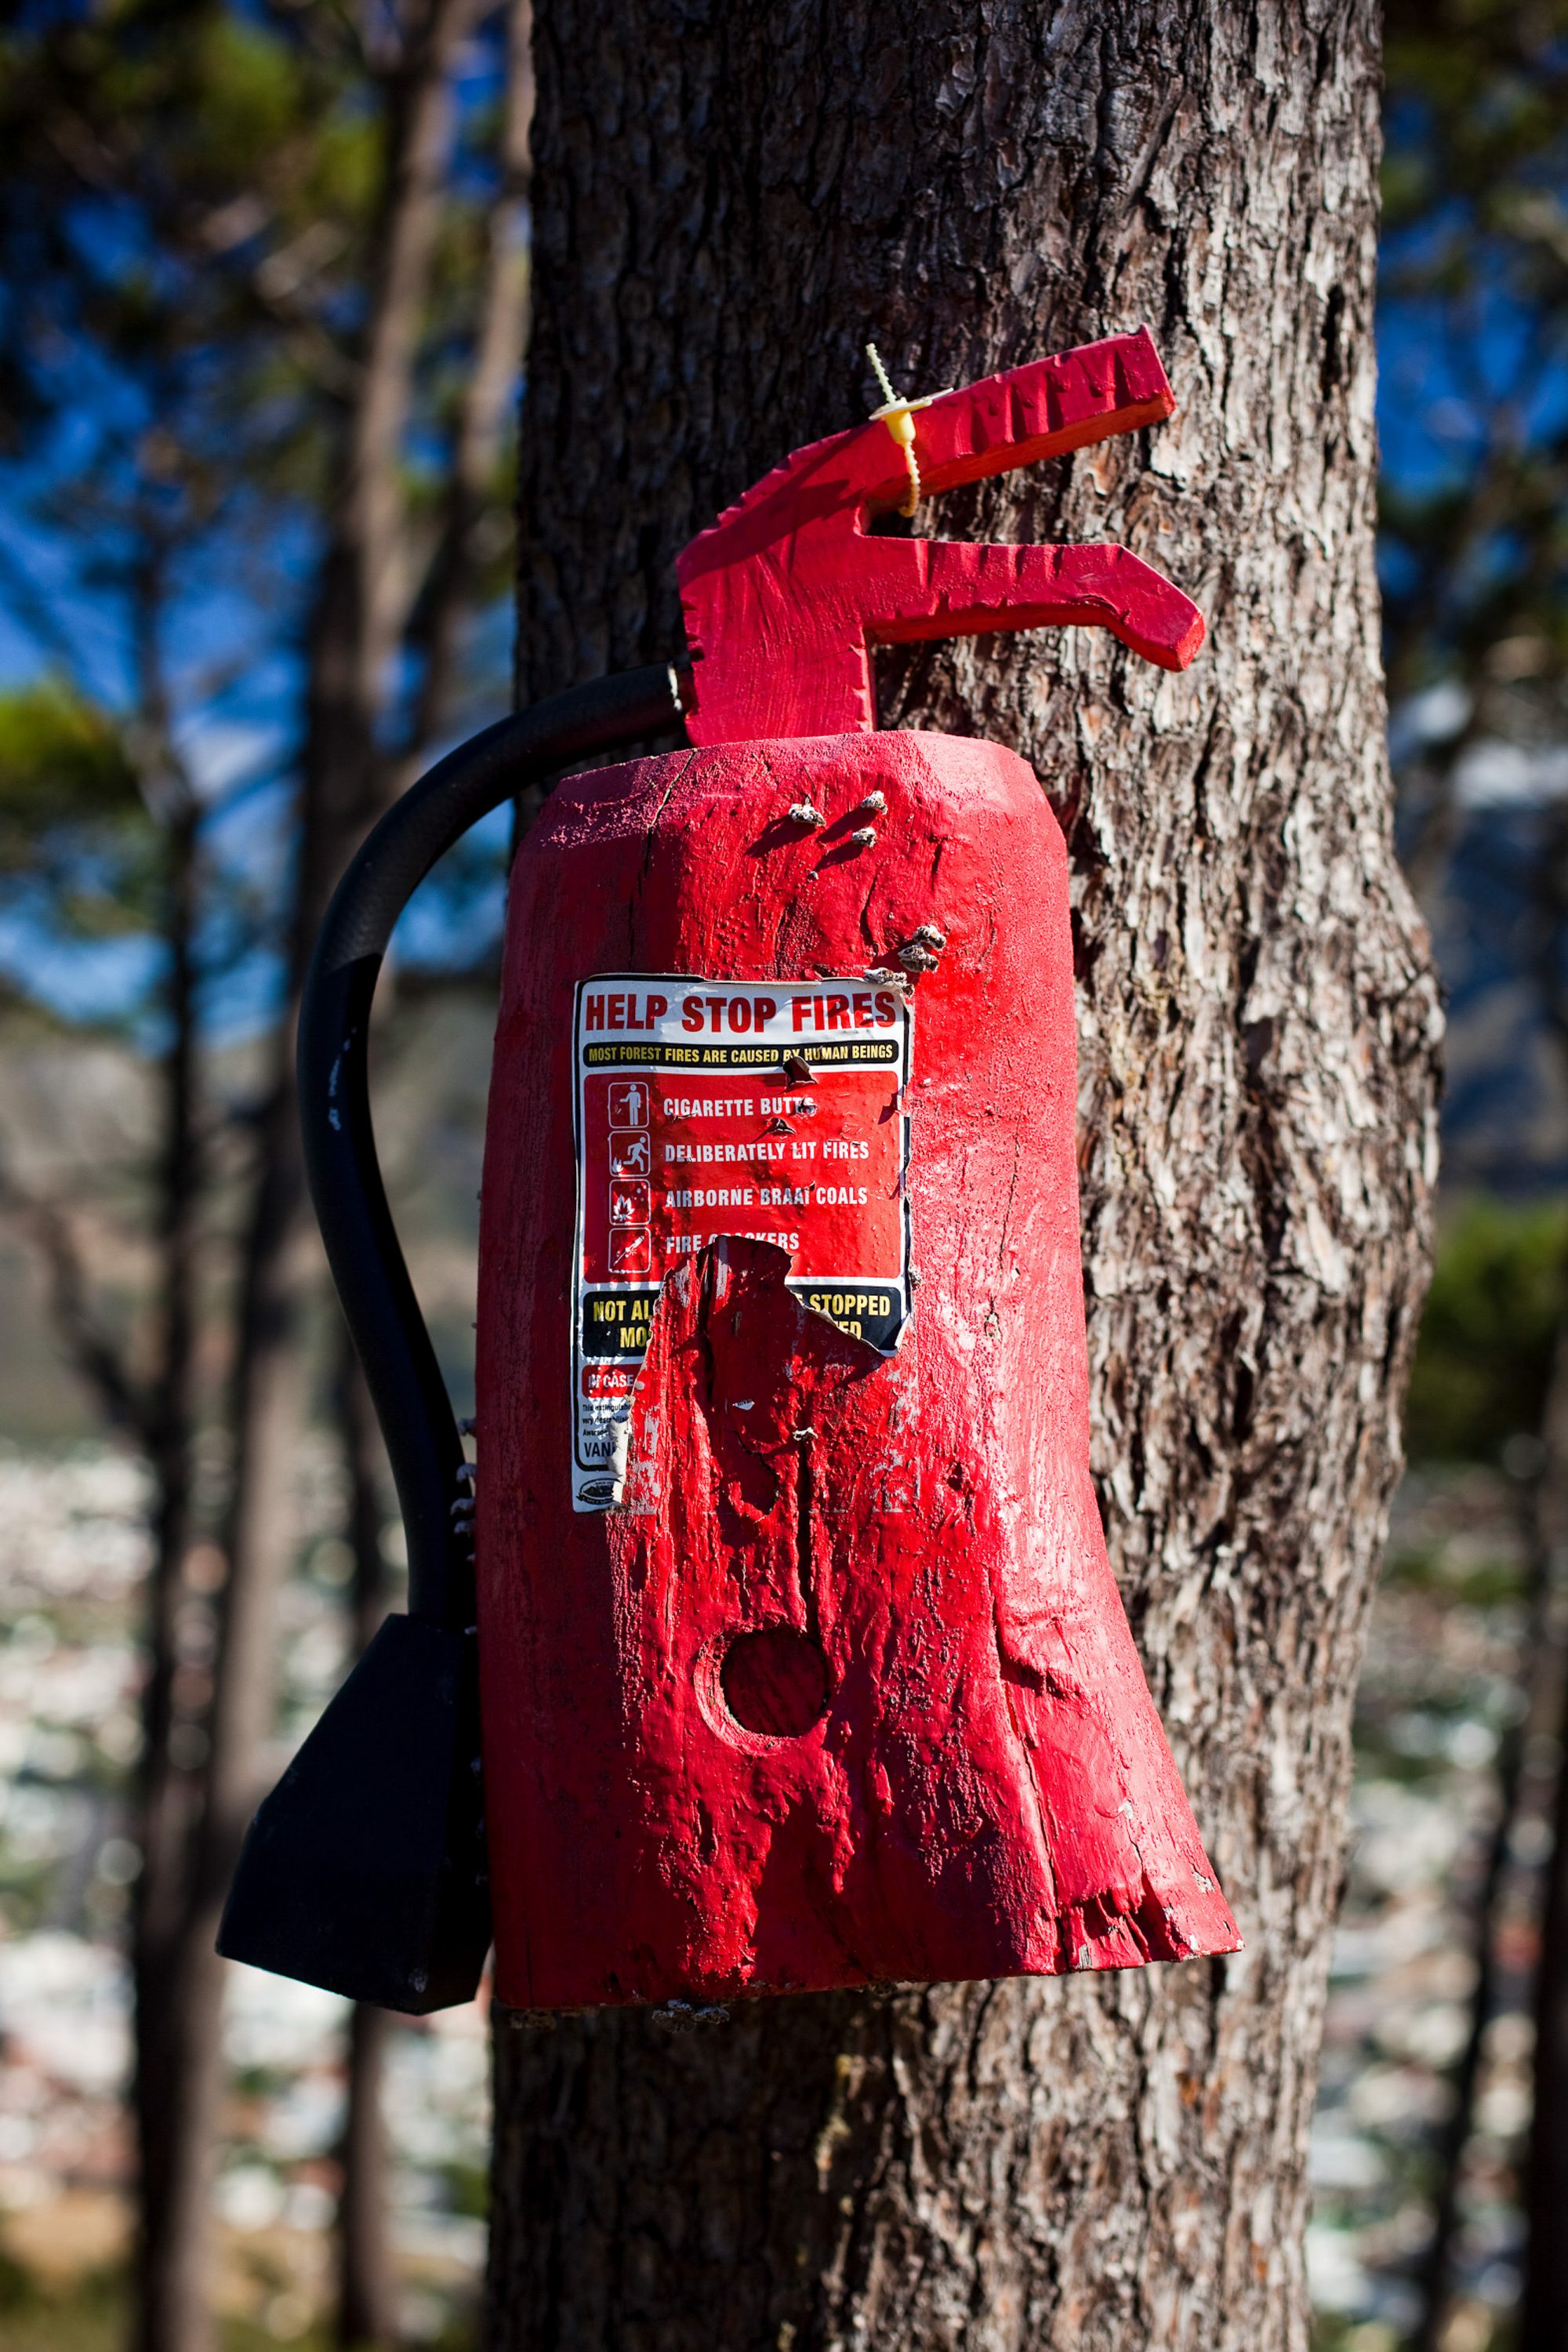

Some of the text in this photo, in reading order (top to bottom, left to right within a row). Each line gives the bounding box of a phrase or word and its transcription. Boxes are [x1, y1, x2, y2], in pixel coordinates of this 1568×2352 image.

[586, 991, 896, 1033] HELP STOP FIRES
[589, 1047, 618, 1062] MOST
[620, 1047, 662, 1061] FOREST
[665, 1048, 699, 1062] FIRES
[703, 1050, 728, 1063] ARE
[731, 1049, 779, 1063] CAUSED
[804, 1046, 849, 1062] HUMAN
[851, 1044, 894, 1059] BEINGS
[663, 1098, 754, 1117] CIGARETTE
[665, 1141, 869, 1163] DELIBERATELY LIT FIRES
[666, 1186, 868, 1208] AIRBORNE BRAAI COALS
[666, 1234, 702, 1254] FIRE
[593, 1300, 627, 1323] NOT
[809, 1294, 891, 1316] STOPPED
[603, 1374, 633, 1388] CASE
